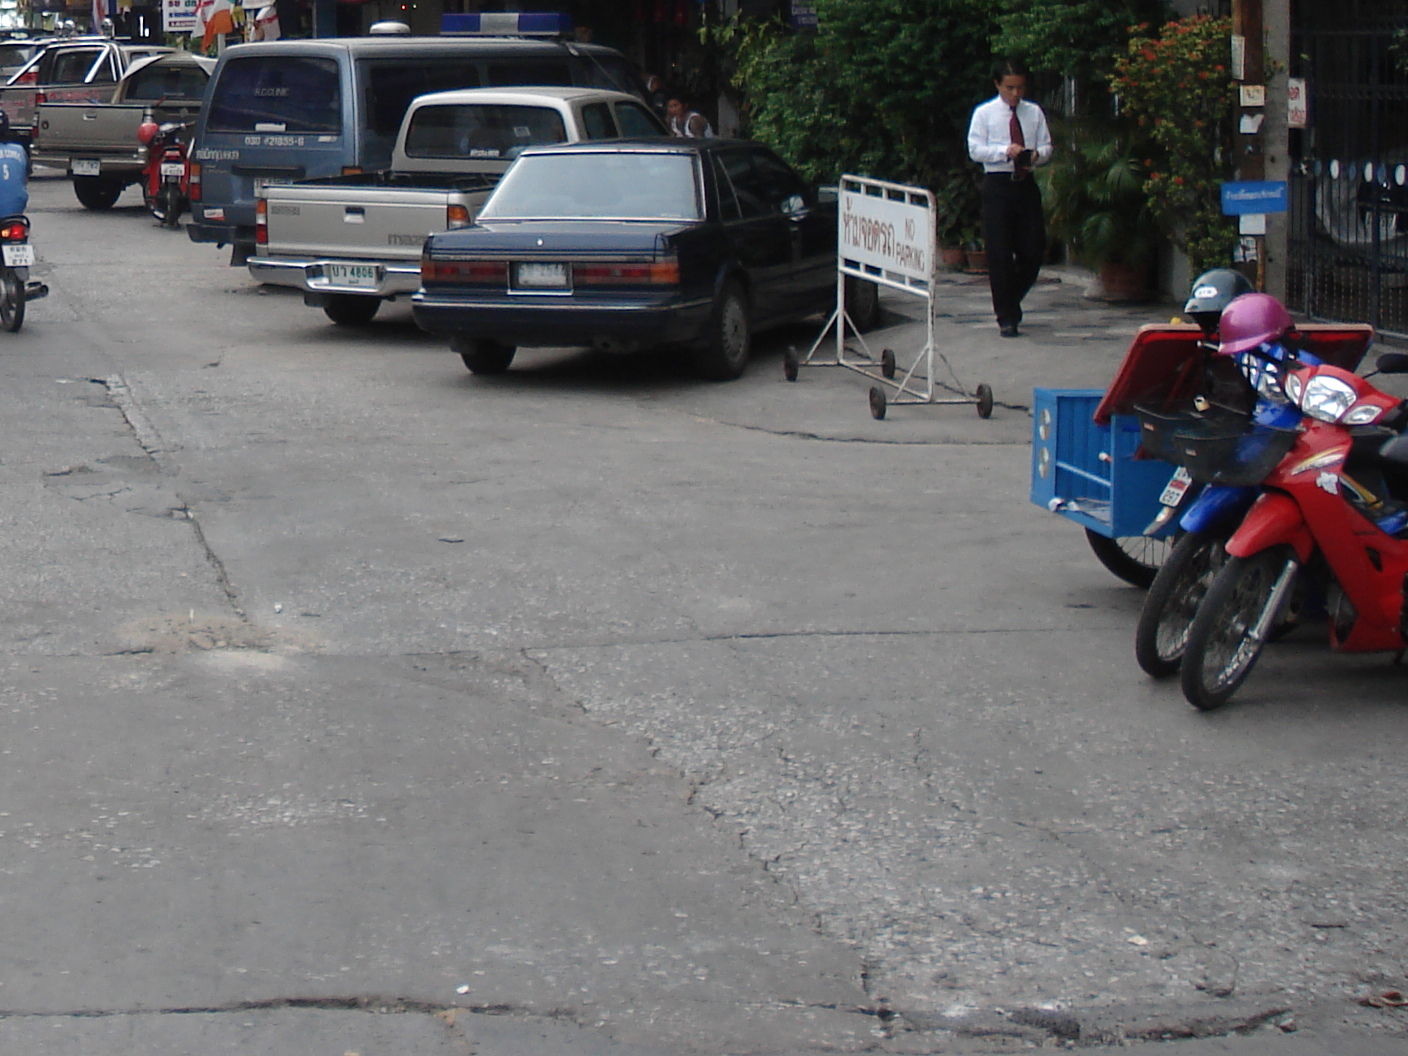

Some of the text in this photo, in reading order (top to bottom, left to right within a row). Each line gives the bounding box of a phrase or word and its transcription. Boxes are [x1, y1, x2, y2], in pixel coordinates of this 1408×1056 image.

[2, 163, 10, 180] 5
[904, 217, 915, 240] NO
[896, 242, 925, 272] PARKING
[350, 266, 375, 279] 4806
